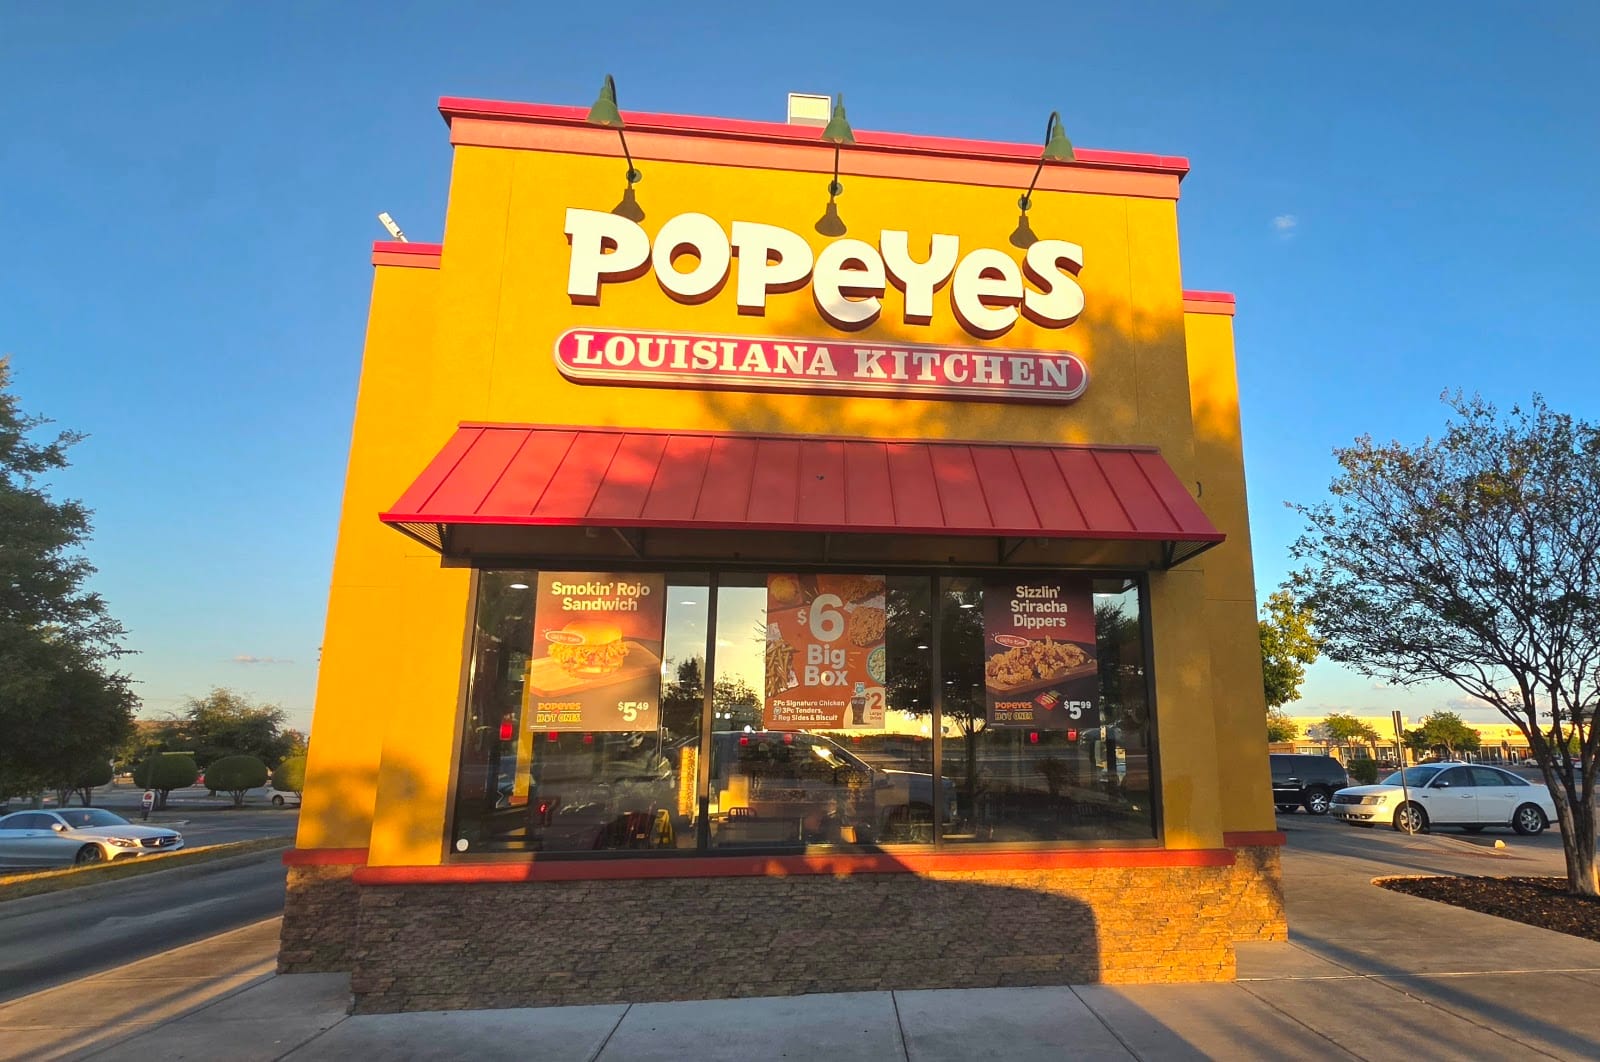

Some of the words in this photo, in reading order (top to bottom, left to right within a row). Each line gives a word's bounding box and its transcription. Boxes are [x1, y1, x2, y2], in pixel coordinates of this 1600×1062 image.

[572, 333, 838, 377] LOUISIANA
[854, 349, 1070, 388] KITCHEN
[617, 582, 650, 598] Rojo
[562, 597, 638, 611] Sandwich
[1011, 600, 1068, 613] Sriracha
[797, 593, 845, 642] $6
[1013, 614, 1067, 629] Dippers
[807, 643, 846, 670] Big
[804, 665, 848, 686] Box
[786, 700, 818, 708] Signature
[865, 692, 882, 710] $2
